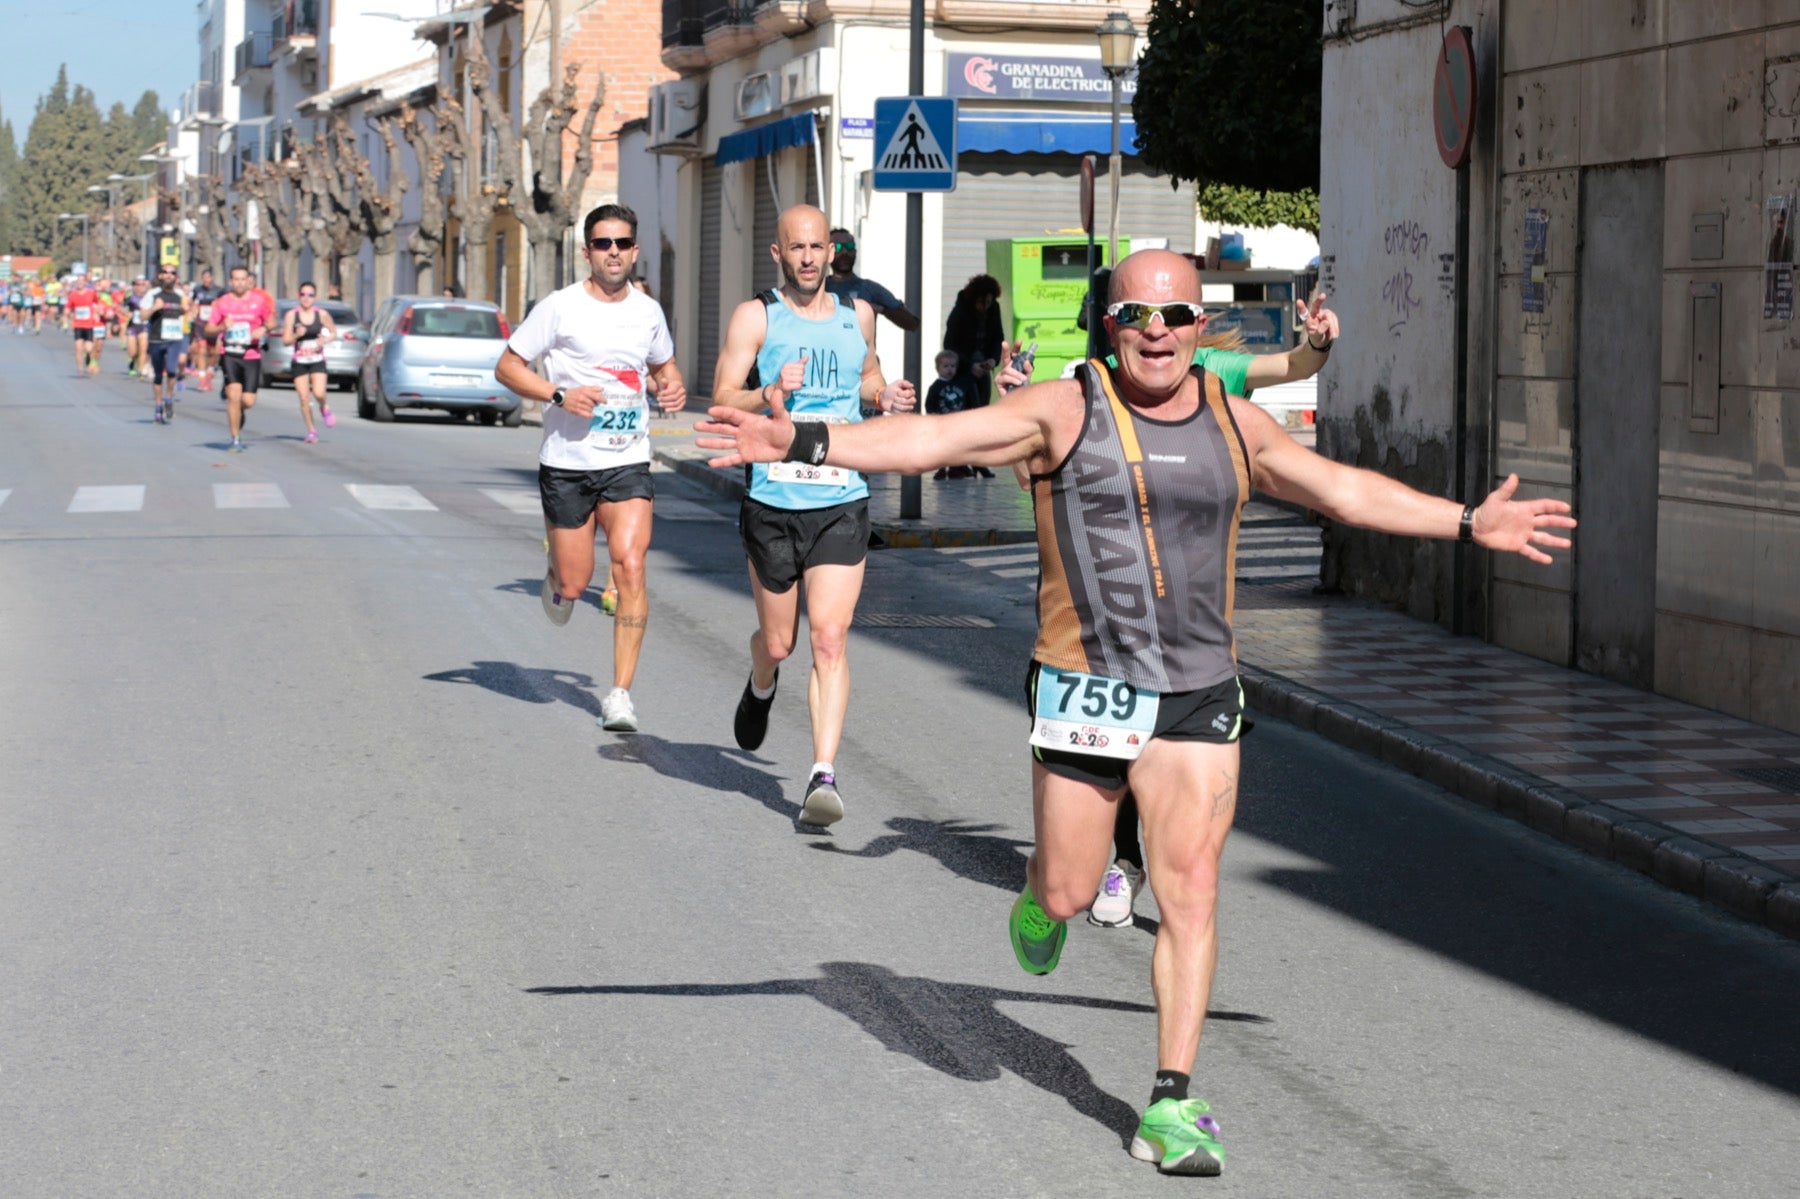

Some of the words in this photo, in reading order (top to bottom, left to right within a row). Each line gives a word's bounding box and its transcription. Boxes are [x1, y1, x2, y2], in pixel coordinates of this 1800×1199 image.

[1001, 63, 1084, 78] GRANADINA
[1012, 77, 1031, 89] DE
[1035, 78, 1137, 93] ELECTRICIAD
[602, 410, 637, 430] 232
[1056, 673, 1138, 721] 759
